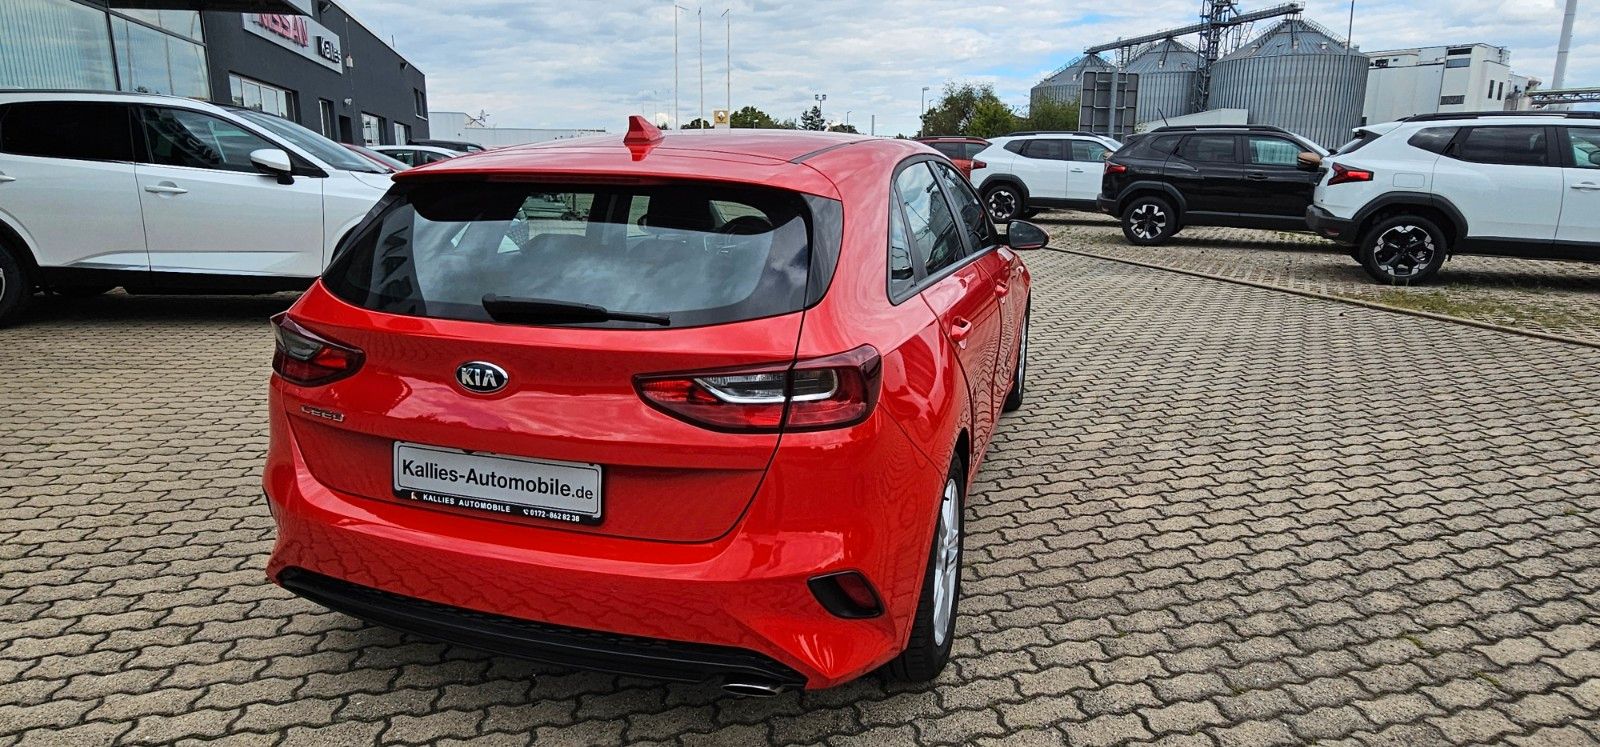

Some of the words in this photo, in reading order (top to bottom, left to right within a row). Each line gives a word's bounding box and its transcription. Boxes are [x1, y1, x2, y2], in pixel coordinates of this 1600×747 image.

[460, 366, 498, 388] KIA
[403, 459, 594, 500] Kallies-Automobile.de
[423, 493, 456, 505] KALLIES
[459, 499, 511, 513] AUTOMOBILE
